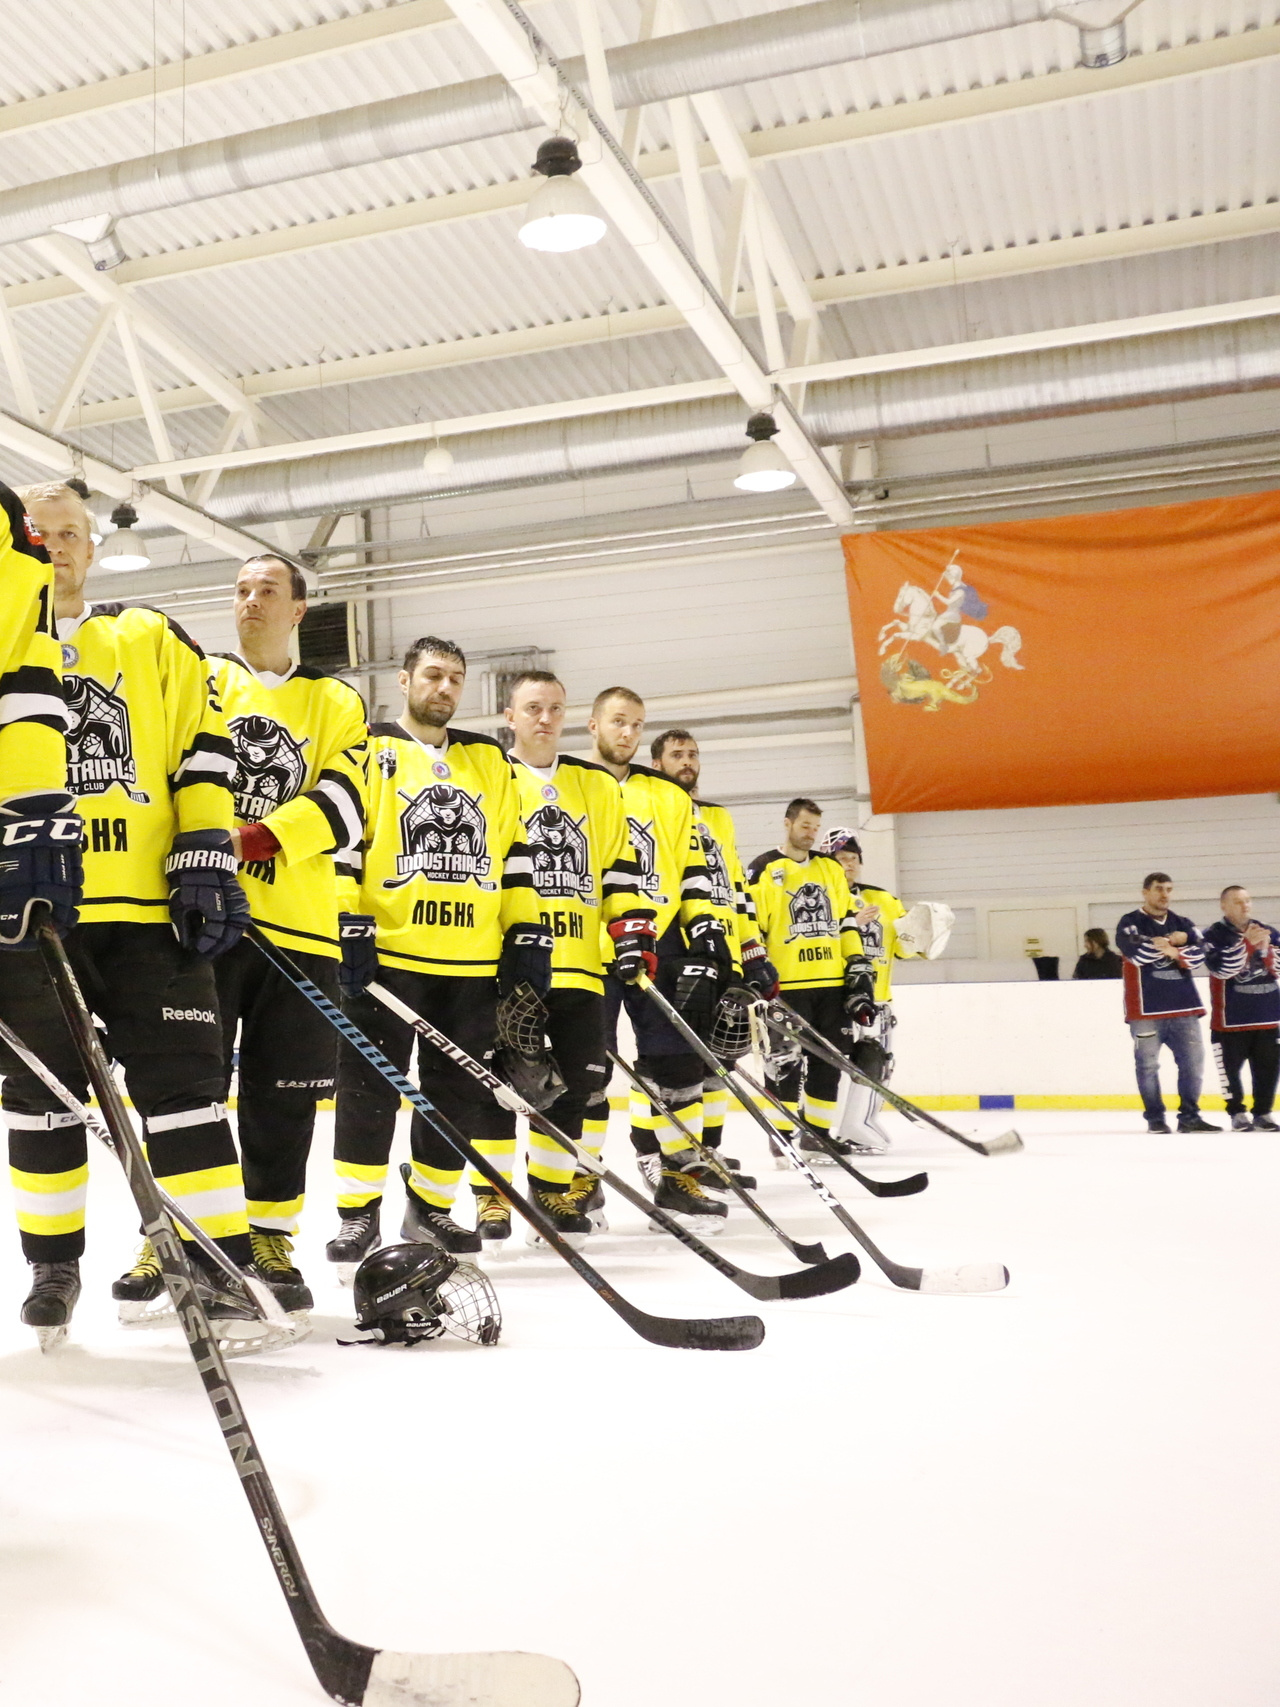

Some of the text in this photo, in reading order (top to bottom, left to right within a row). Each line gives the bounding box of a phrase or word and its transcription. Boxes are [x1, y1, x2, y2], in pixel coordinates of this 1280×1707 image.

[84, 782, 105, 792] CLUB
[3, 818, 83, 847] CC
[398, 852, 490, 876] INDUSTRIALS
[427, 871, 467, 881] HOCKEY CLUB
[412, 899, 474, 928] ЛОБНЯ
[341, 925, 377, 938] CM
[624, 920, 657, 933] CC
[690, 920, 725, 939] CC
[514, 933, 554, 947] CC
[682, 965, 719, 980] CC
[161, 1006, 217, 1025] Reebok
[275, 1078, 335, 1089] EASTON
[376, 1283, 408, 1304] BAUER
[155, 1238, 263, 1479] EASTON
[260, 1516, 300, 1598] SYNERGY
